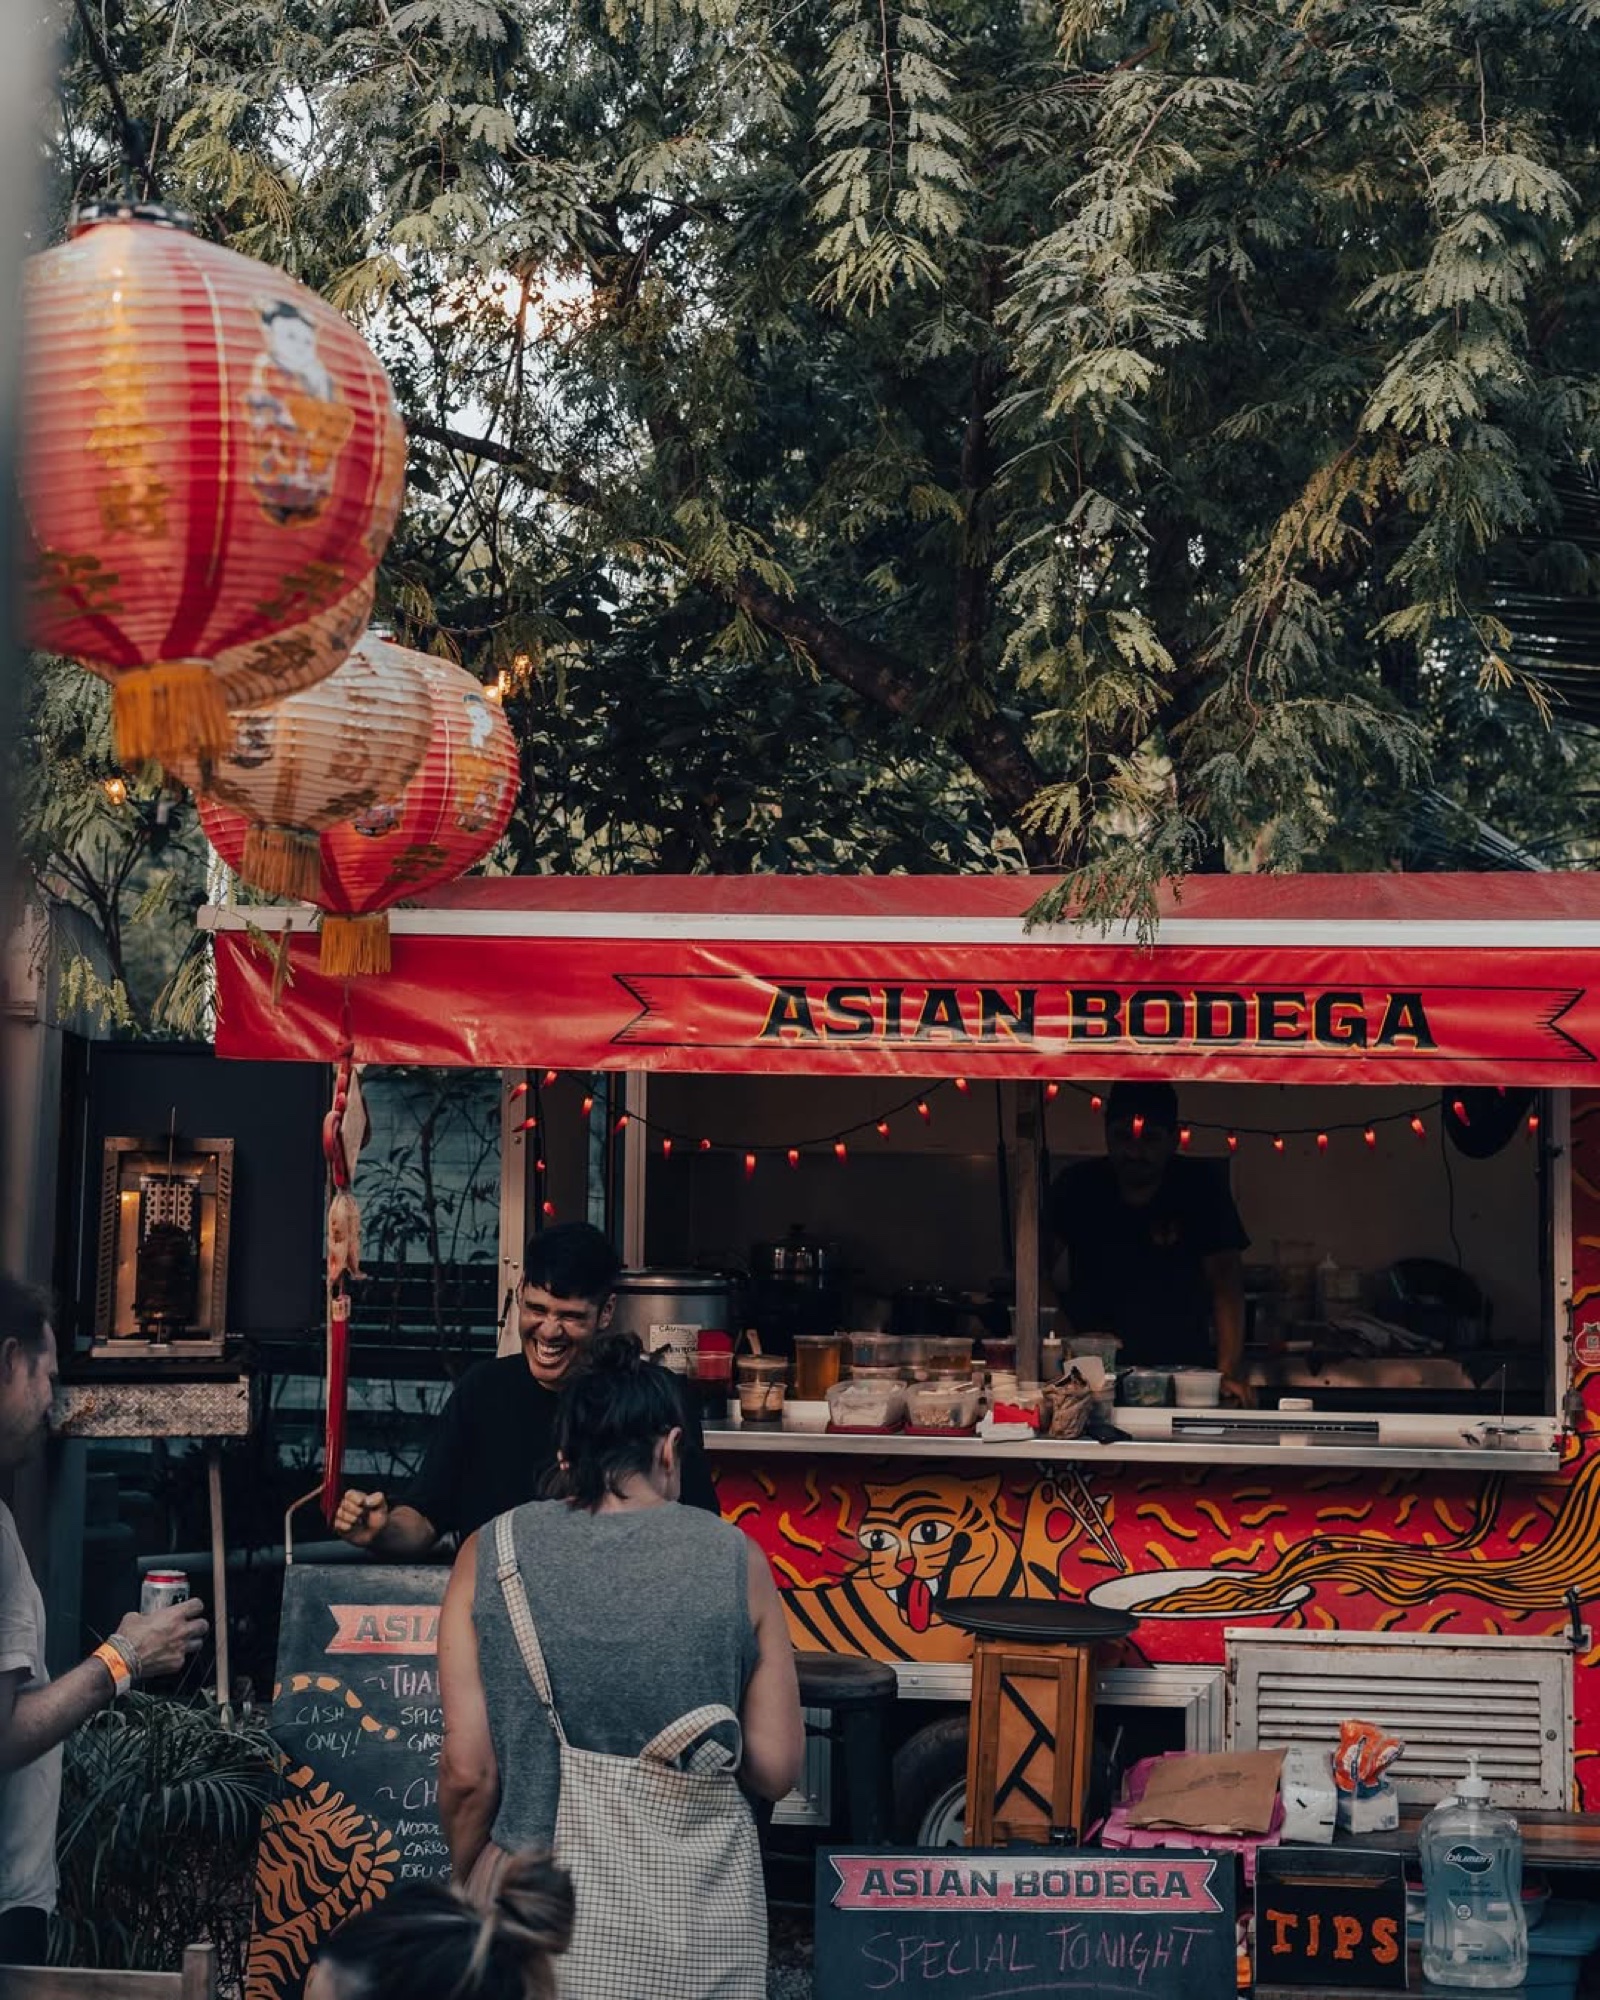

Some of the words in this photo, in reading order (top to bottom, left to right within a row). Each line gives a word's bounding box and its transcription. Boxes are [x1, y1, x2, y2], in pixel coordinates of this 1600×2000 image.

[757, 984, 1039, 1047] ASIAN
[1065, 988, 1439, 1052] BODEGA
[294, 1704, 345, 1725] CASH
[306, 1728, 362, 1758] ONLY!
[860, 1868, 999, 1898] ASIAN
[1012, 1868, 1193, 1900] BODEGA
[860, 1930, 1036, 1989] SPECIAL
[1046, 1923, 1214, 1986] TONIGHT
[1265, 1908, 1400, 1965] TIPS
